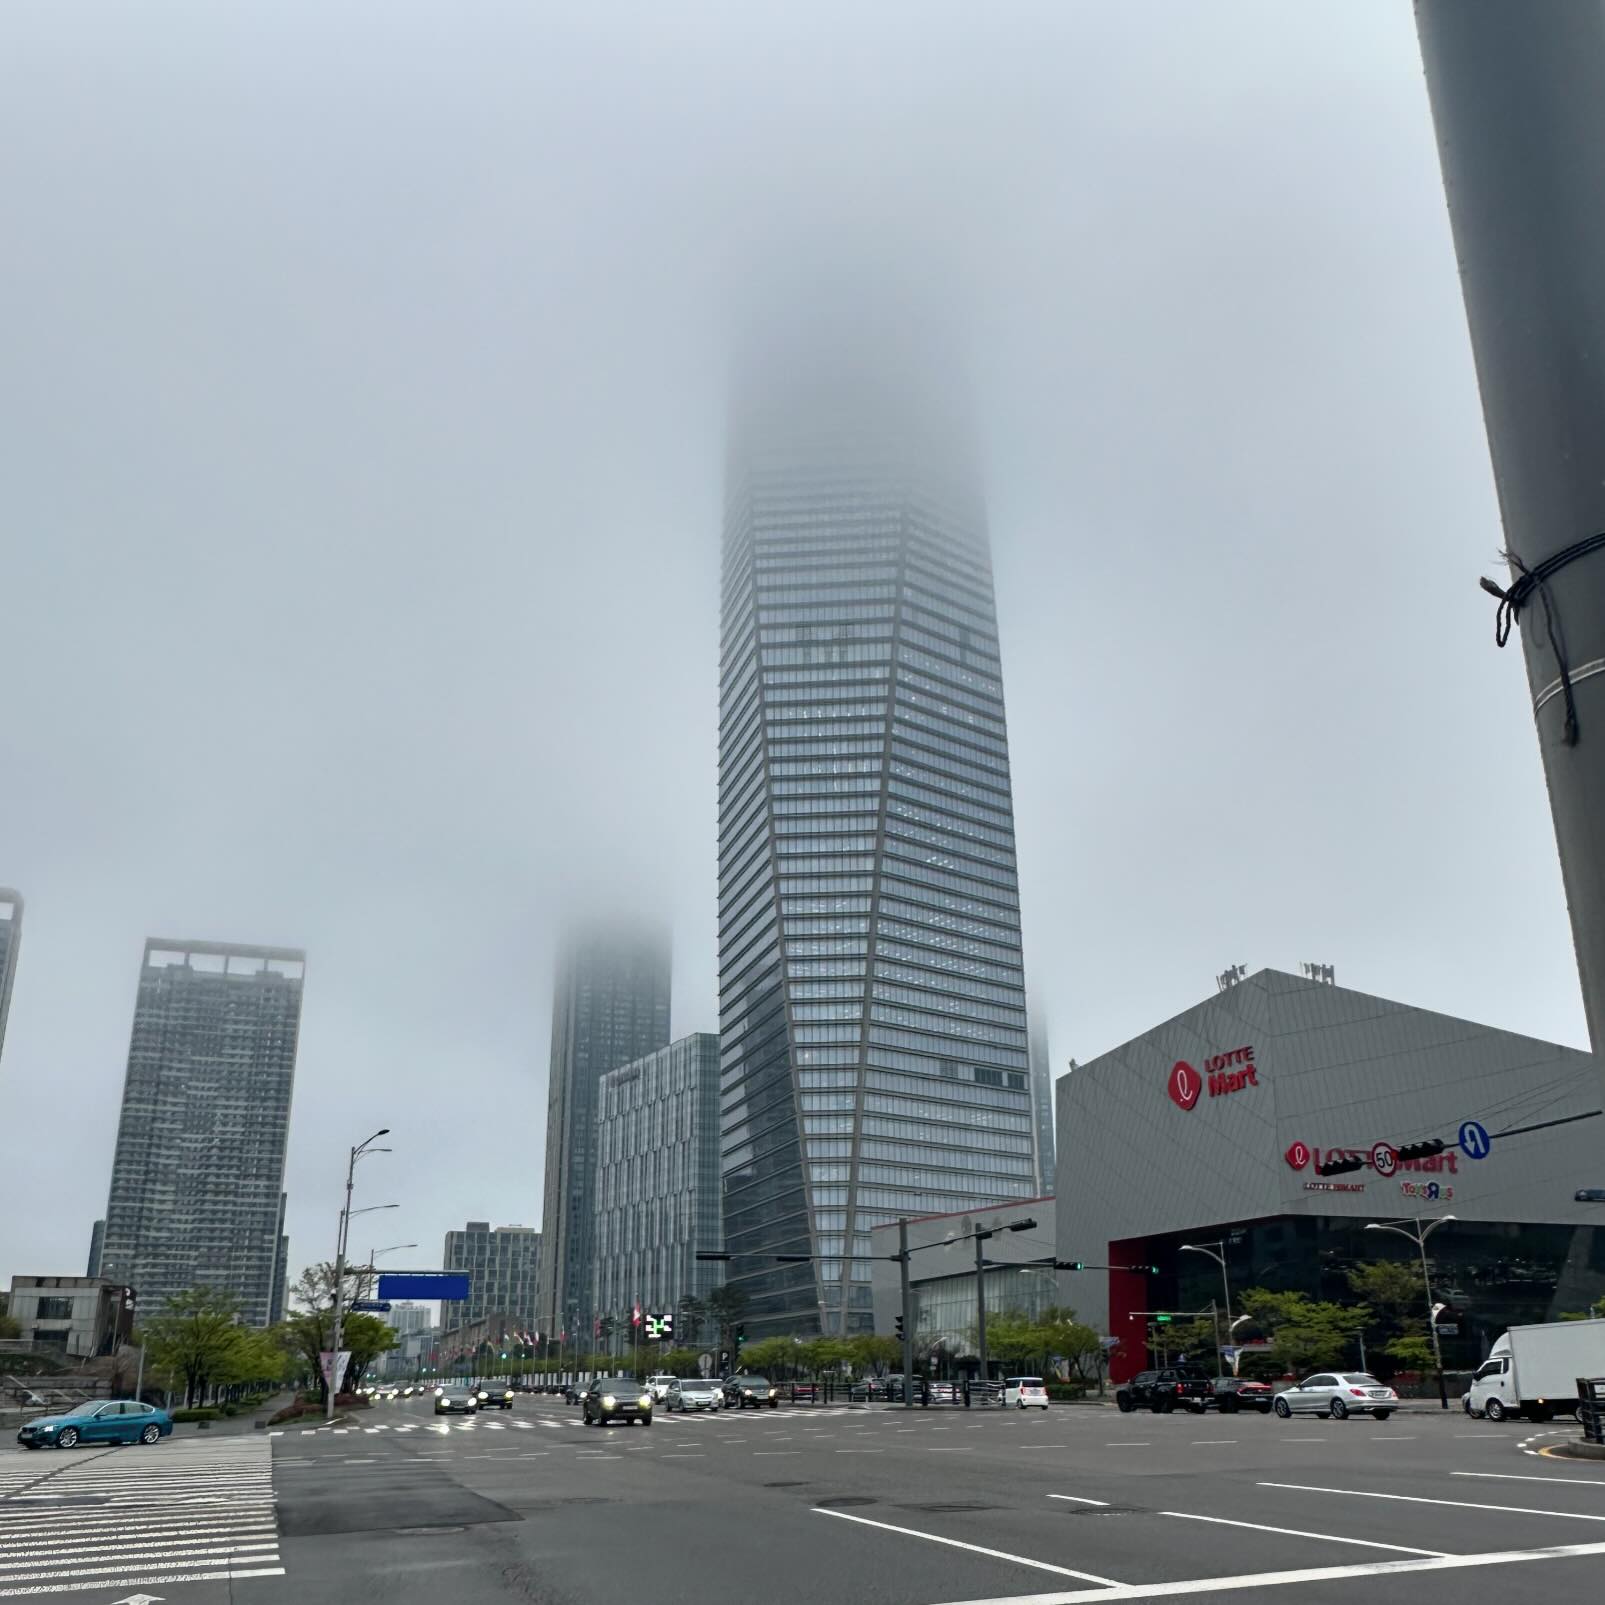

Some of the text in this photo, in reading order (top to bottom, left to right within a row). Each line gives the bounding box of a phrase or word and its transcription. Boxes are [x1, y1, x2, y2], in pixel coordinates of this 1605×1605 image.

[1204, 1046, 1255, 1073] LOTTE
[1208, 1063, 1259, 1097] Mart
[1376, 1151, 1393, 1169] 50
[722, 1352, 728, 1360] P
